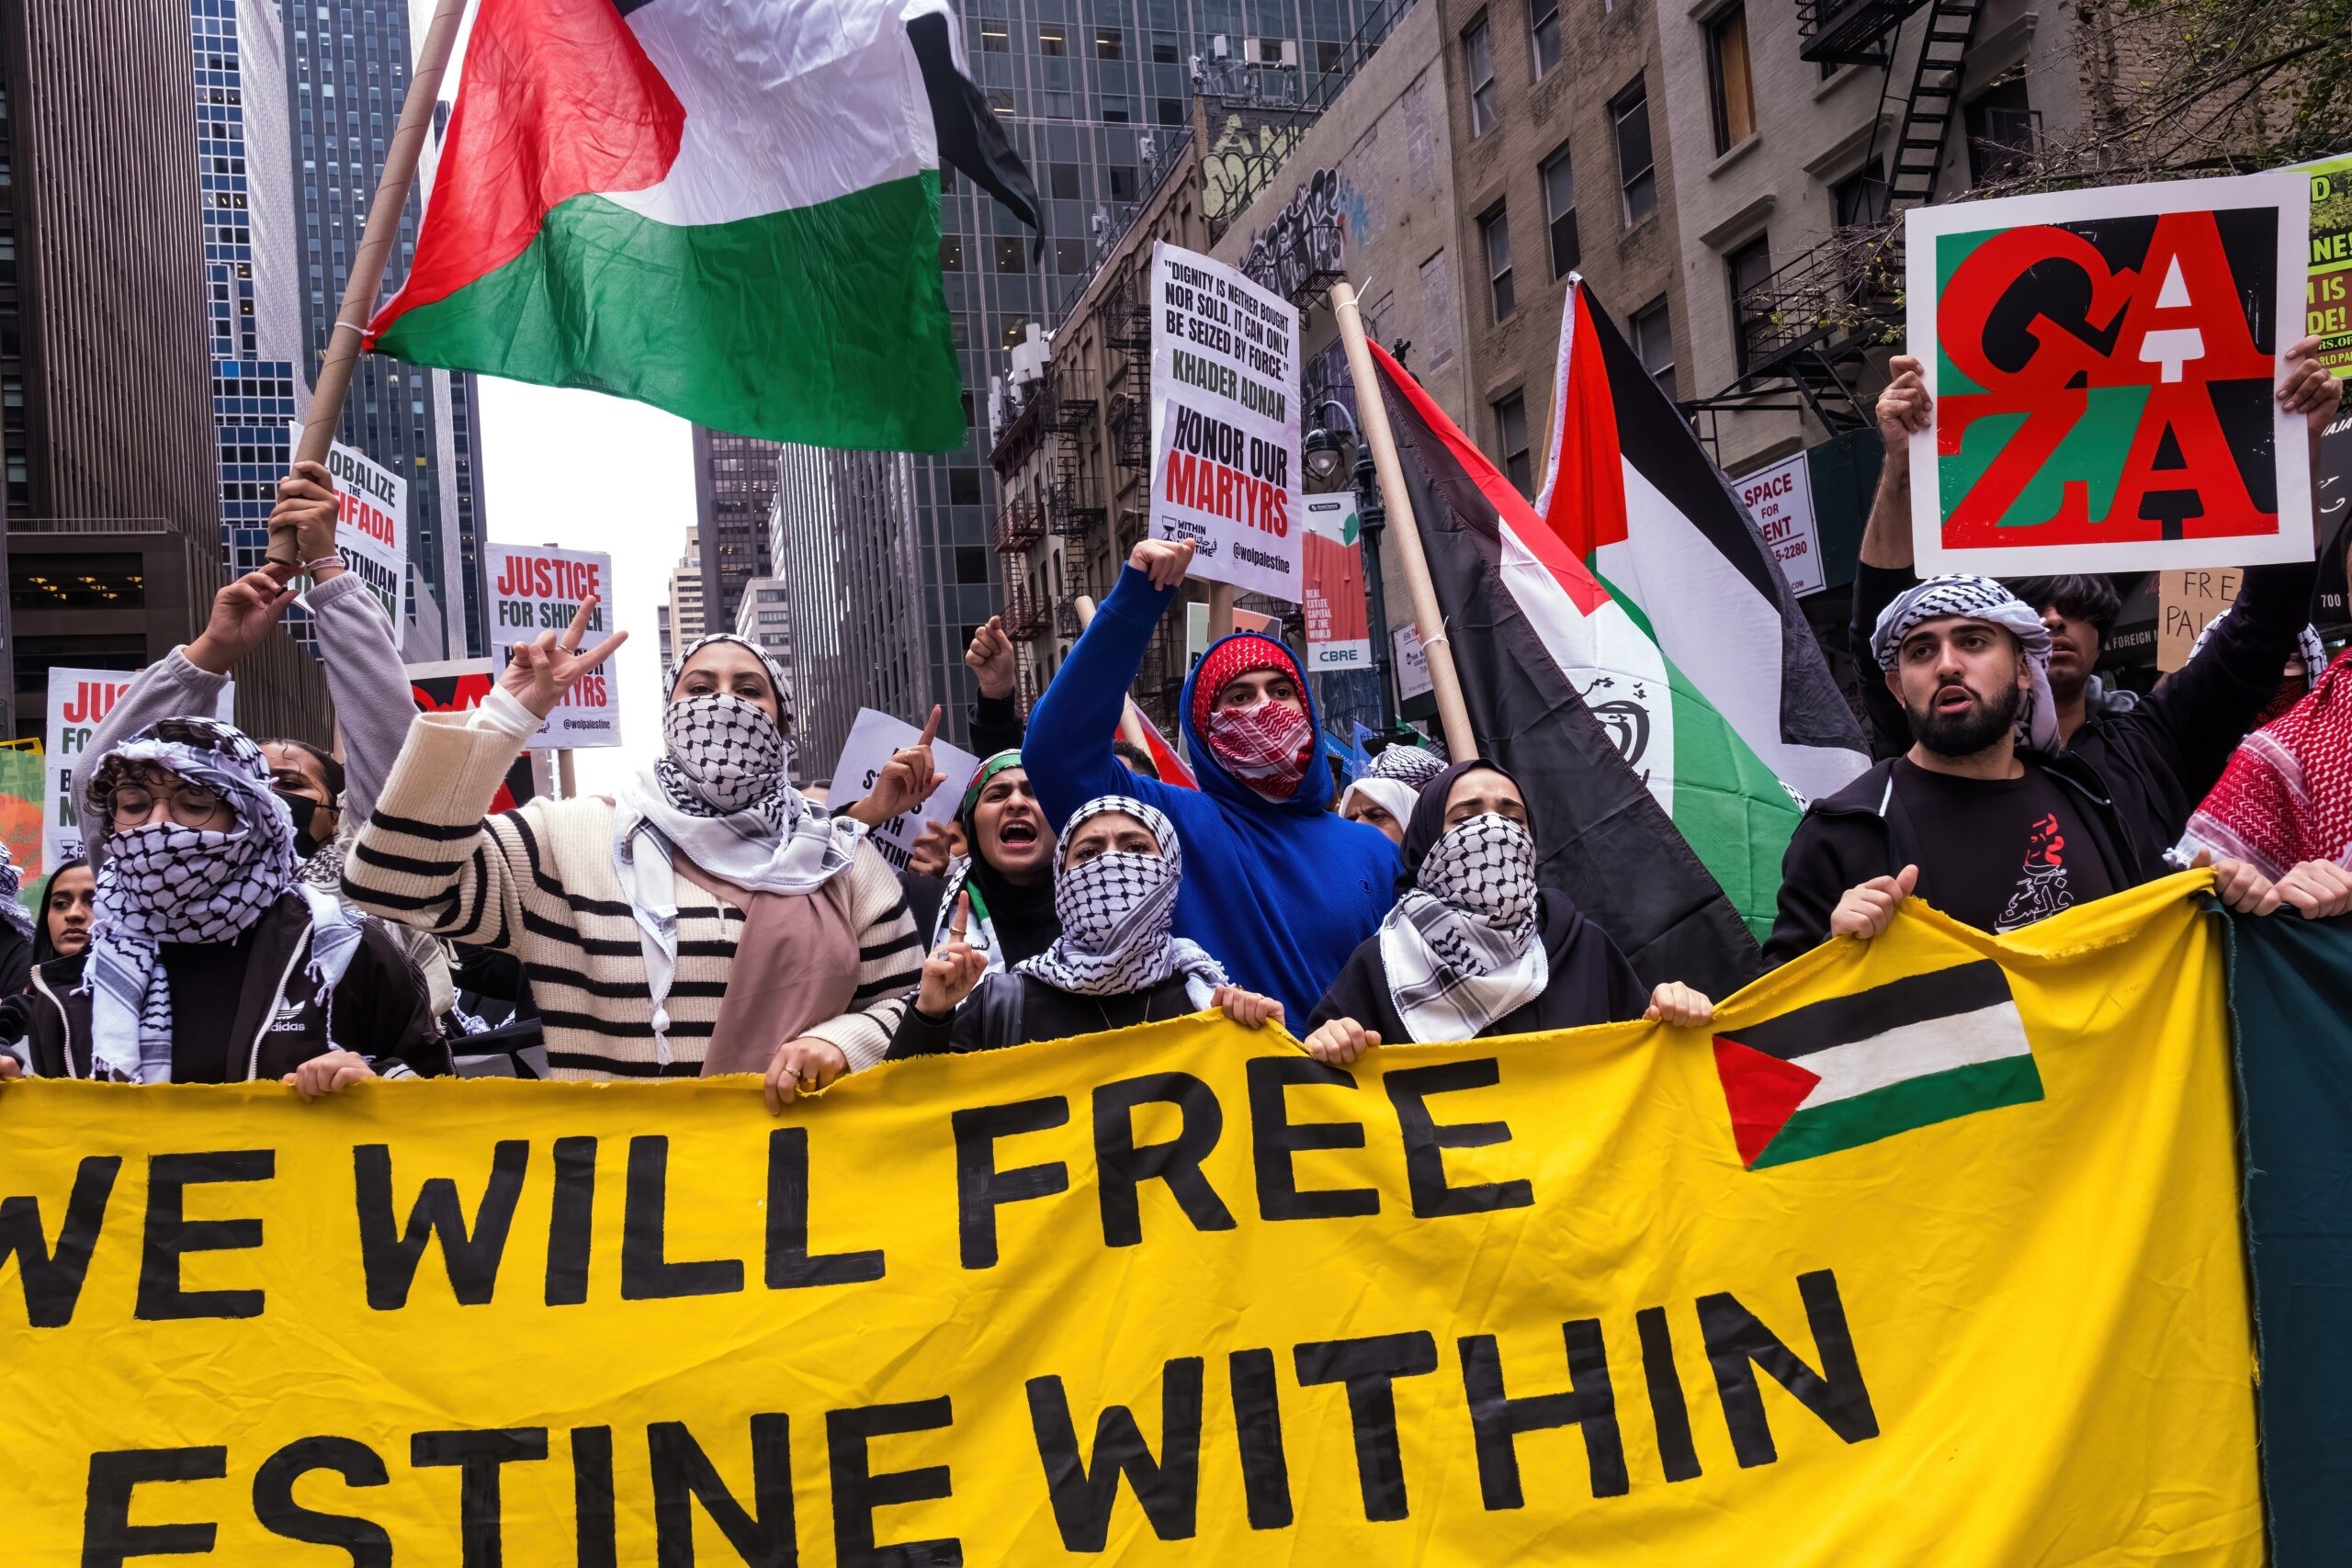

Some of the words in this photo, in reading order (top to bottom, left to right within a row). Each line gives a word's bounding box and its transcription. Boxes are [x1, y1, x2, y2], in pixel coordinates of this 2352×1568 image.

[1164, 259, 1214, 293] "DIGNITY
[1216, 277, 1226, 298] IS
[1228, 283, 1258, 318] NEITHER
[1261, 302, 1289, 333] BOUGHT
[1165, 281, 1193, 311] NOR
[1197, 293, 1231, 327] SOLD.
[1234, 309, 1243, 333] IT
[1245, 316, 1263, 345] CAN
[1267, 327, 1289, 358] ONLY
[2308, 306, 2346, 334] DE!
[1166, 309, 1184, 337] BE
[1188, 317, 1230, 355] SEIZED
[1234, 335, 1247, 363] BY
[1250, 344, 1289, 382] FORCE."
[2319, 354, 2336, 367] RLD
[1172, 348, 1238, 400] KHADER
[1241, 375, 1285, 423] ADNAN
[1173, 405, 1244, 472] HONOR
[1250, 436, 1287, 489] OUR
[328, 450, 396, 508] OBALIZE
[348, 483, 362, 499] THE
[1744, 472, 1793, 508] SPACE
[1166, 448, 1288, 538] MARTYRS
[334, 489, 395, 549] IFADA
[1760, 503, 1779, 519] FOR
[1178, 519, 1206, 536] WITHIN
[1761, 515, 1792, 542] ENT
[1195, 544, 1214, 558] TIME
[1233, 542, 1290, 574] @wolpalestine
[1775, 540, 1807, 562] 5-2280
[497, 555, 602, 603] JUSTICE
[1792, 580, 1804, 590] COM
[1306, 589, 1320, 598] REAL
[1306, 598, 1329, 608] ESTATE
[2321, 593, 2341, 608] 700
[498, 600, 534, 627] FOR
[1307, 608, 1332, 618] CAPITAL
[1308, 619, 1317, 629] OF
[1317, 619, 1329, 628] THE
[1308, 628, 1331, 638] WORLD
[2112, 630, 2152, 649] FOREIGN
[1319, 649, 1358, 662] CBRE
[563, 718, 611, 730] @wolpalestine
[0, 1149, 276, 1328] WE
[352, 1126, 886, 1312] WILL
[952, 1055, 1534, 1269] FREE
[1024, 1268, 1880, 1553] WITHIN
